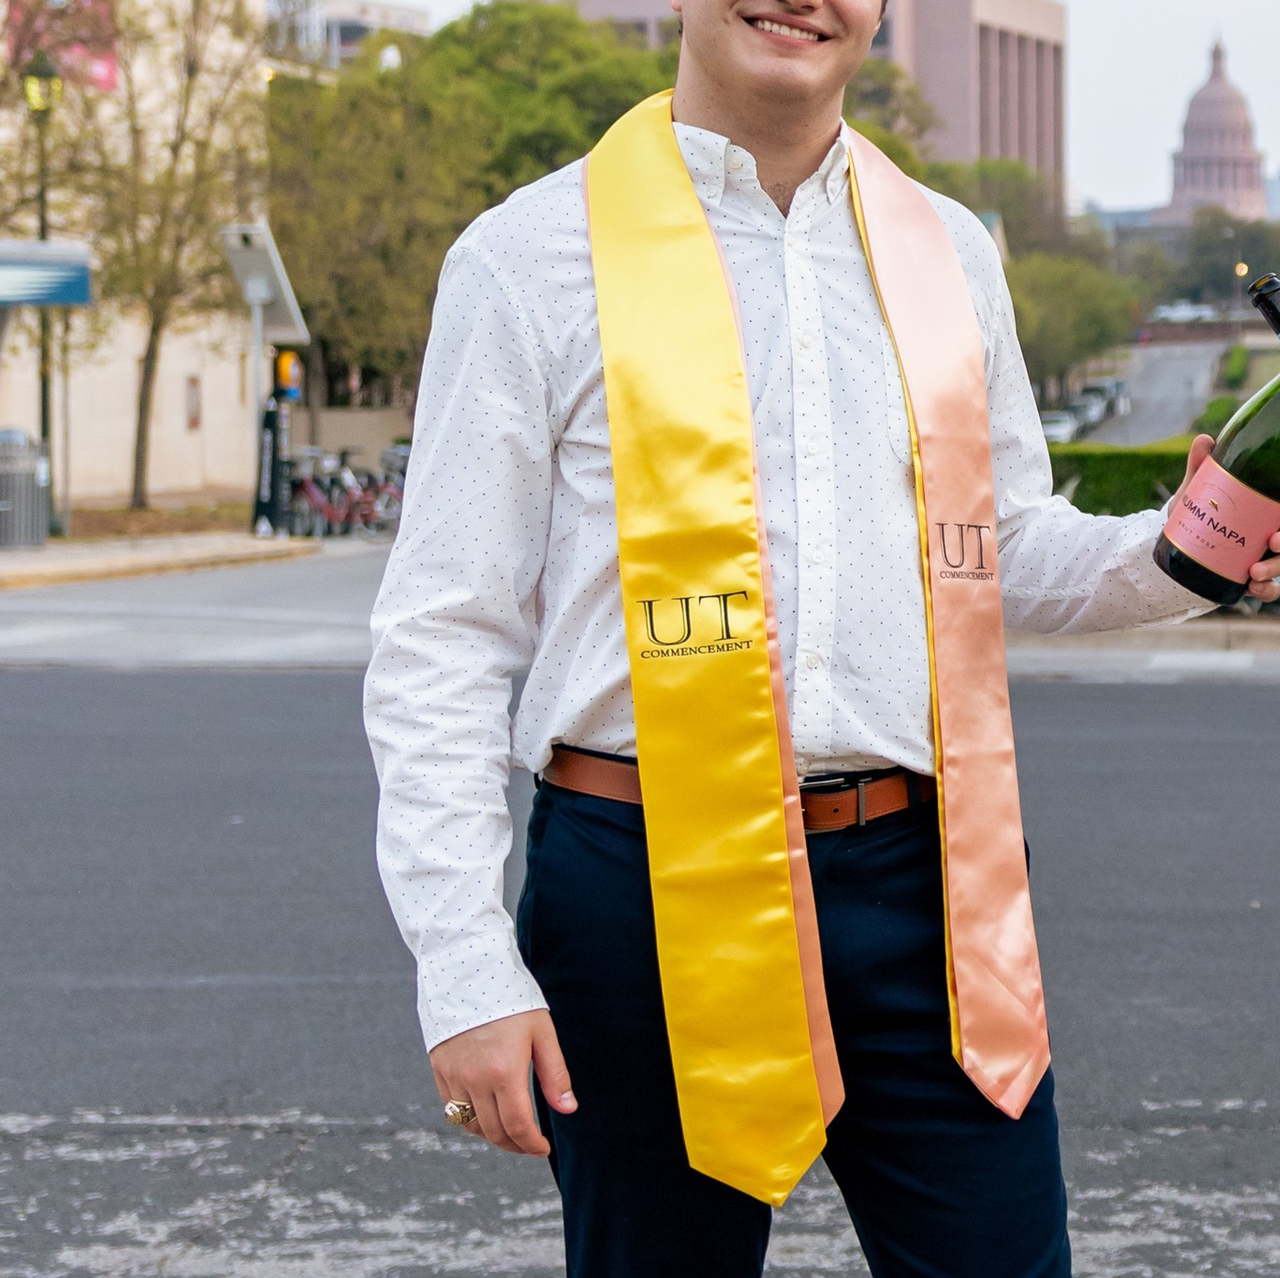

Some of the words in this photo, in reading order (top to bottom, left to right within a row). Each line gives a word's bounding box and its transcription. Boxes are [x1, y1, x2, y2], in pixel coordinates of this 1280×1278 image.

[935, 522, 991, 570] UT
[1206, 518, 1247, 548] NAPA
[940, 570, 994, 581] COMMENCEMENT
[636, 590, 749, 646] UT
[640, 640, 753, 659] COMMENCEMENT
